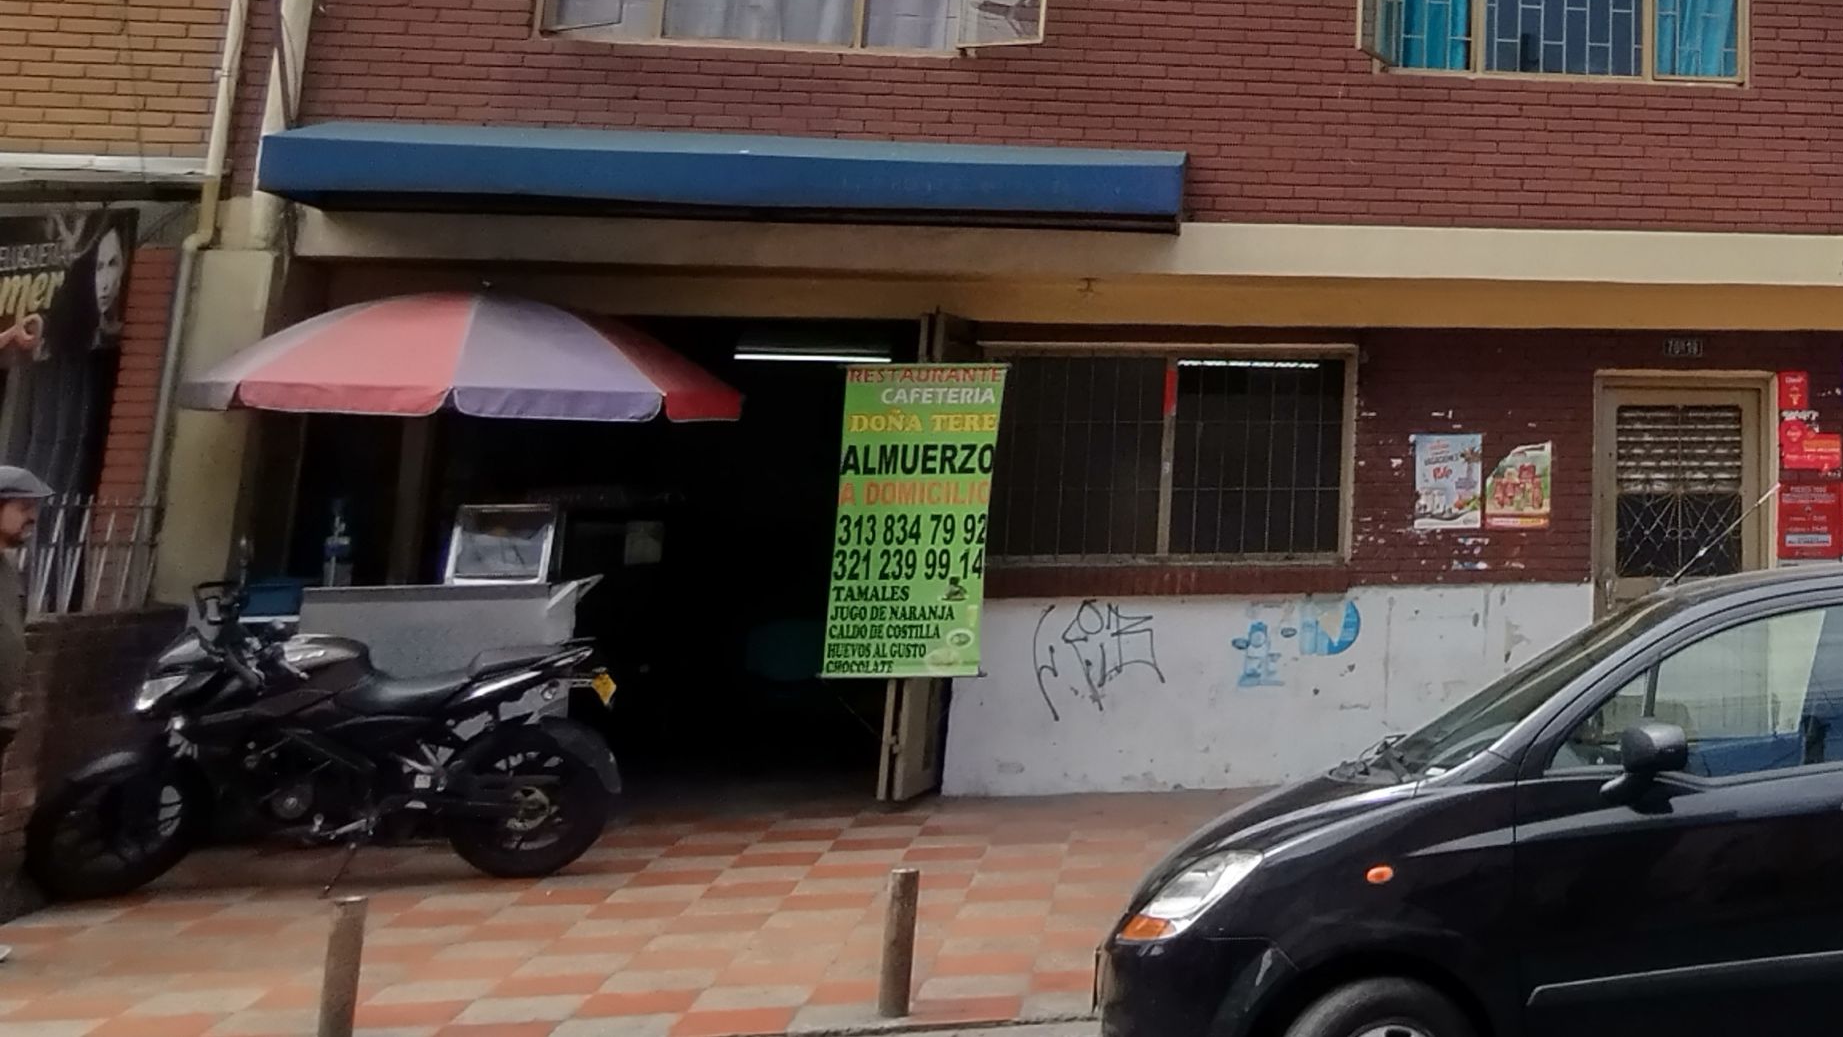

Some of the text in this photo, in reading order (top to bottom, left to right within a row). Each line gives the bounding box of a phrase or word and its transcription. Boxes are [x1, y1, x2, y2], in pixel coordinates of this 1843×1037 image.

[848, 367, 1002, 383] RESTAURANTE
[881, 387, 996, 404] CAFETERIA
[850, 409, 998, 433] DOÑA TERE
[840, 444, 994, 475] ALMUERZO
[839, 482, 856, 505] A
[838, 514, 986, 546] 313 834 79 92
[833, 548, 984, 581] 321 239 99 14
[832, 585, 911, 602] TAMALES
[830, 605, 955, 621] JUGO DE NARANJA
[828, 624, 941, 639] CALDO DE COSTILLA
[826, 643, 927, 658] HUEVOS AL GUSTO
